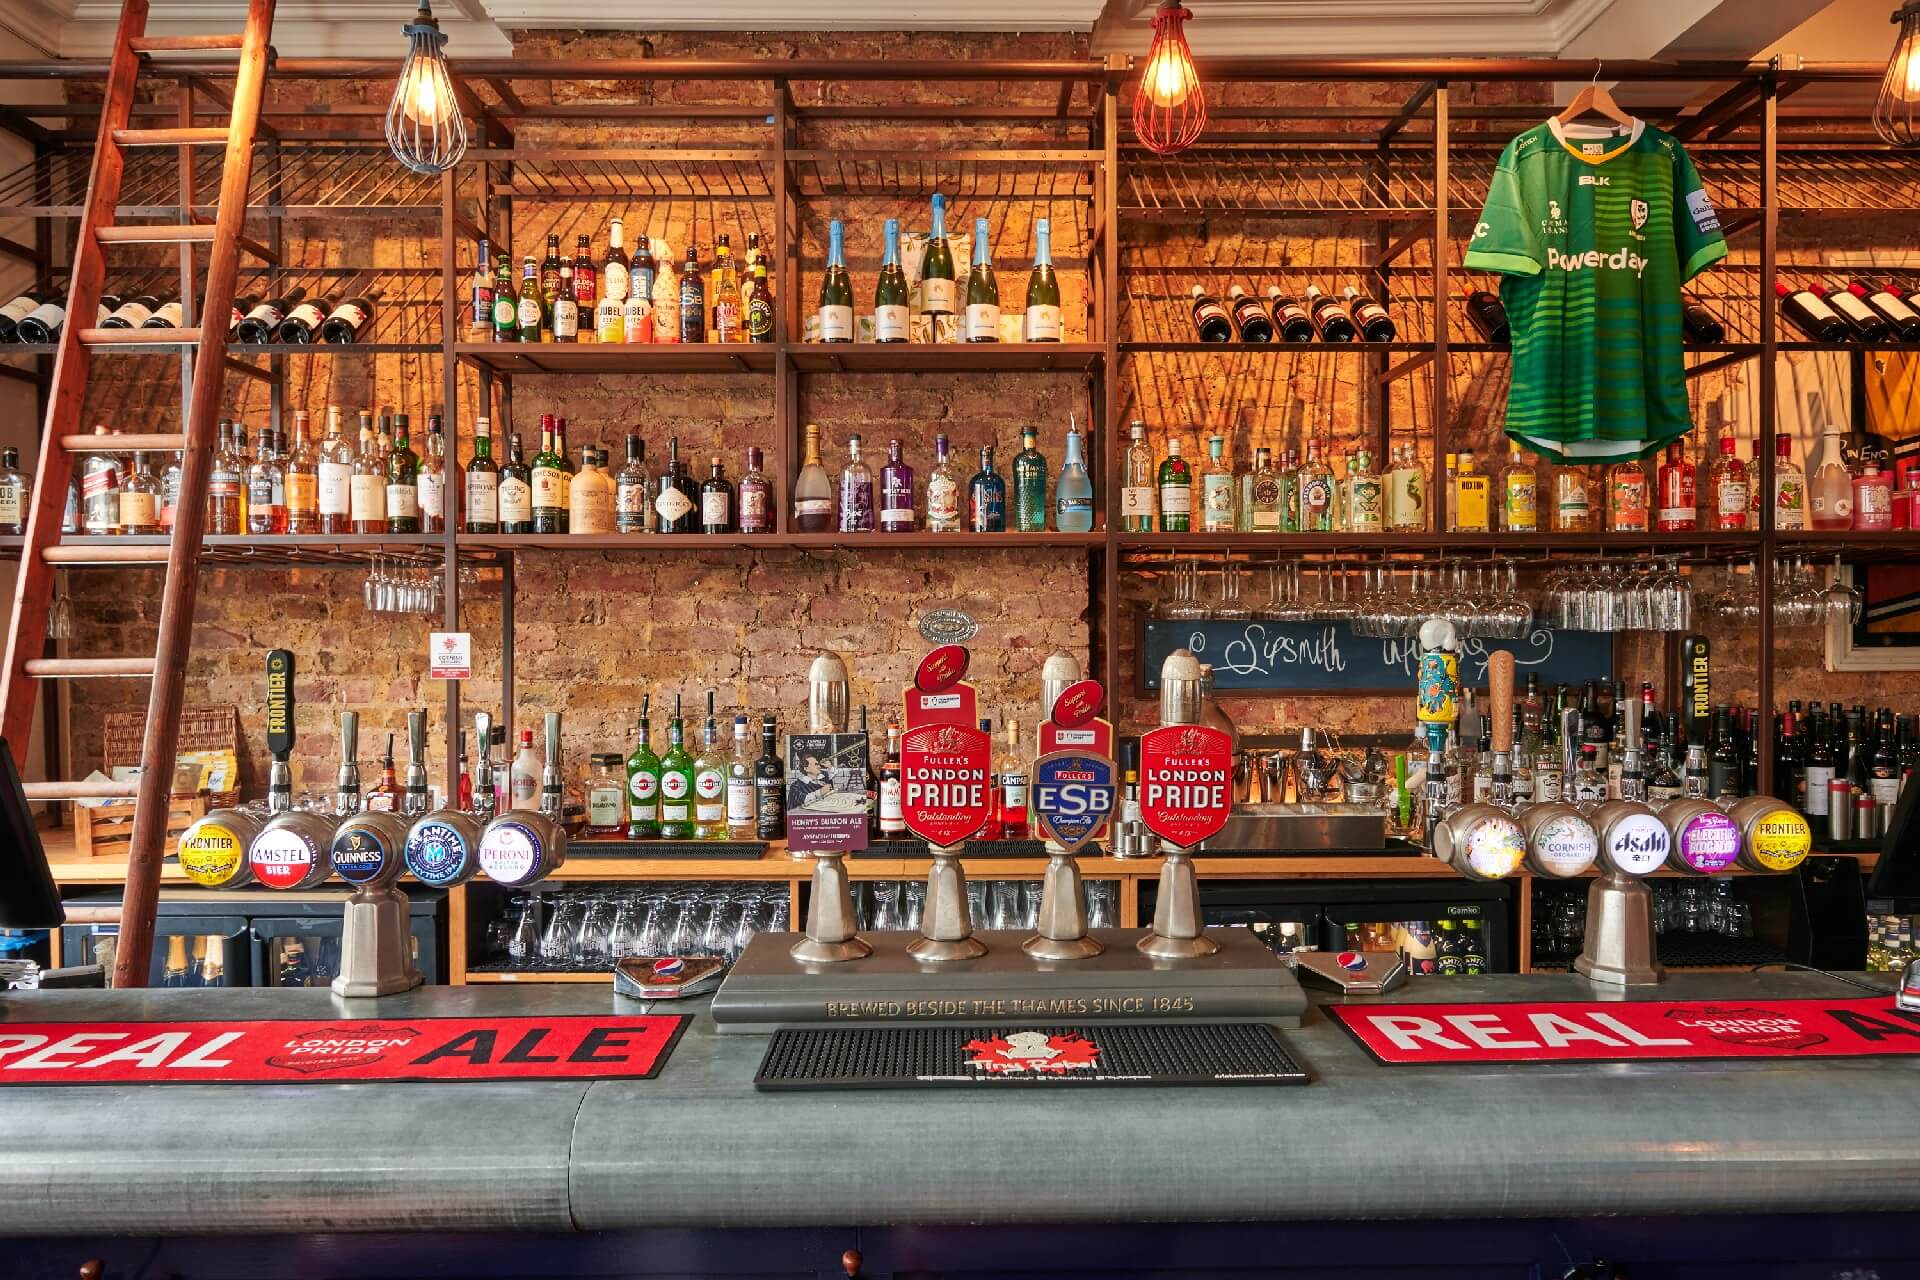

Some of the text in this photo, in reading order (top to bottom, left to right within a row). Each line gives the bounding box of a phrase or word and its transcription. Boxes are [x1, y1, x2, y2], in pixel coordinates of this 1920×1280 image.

[1578, 175, 1611, 186] BLK
[1547, 247, 1649, 279] Powerday
[600, 306, 622, 317] JUBEL
[625, 306, 645, 317] JUBEL
[1461, 480, 1484, 490] HOXTON
[1128, 494, 1138, 507] 3
[1225, 624, 1346, 675] Sipsmith
[1693, 656, 1709, 718] FRONTIER
[268, 672, 286, 734] FRONTIER
[1064, 689, 1087, 707] Support
[923, 755, 969, 765] FULLER'S
[1164, 757, 1210, 767] FULLER'S
[906, 767, 984, 780] LONDON
[1002, 775, 1026, 785] CAMPA
[1147, 769, 1225, 782] LONDON
[881, 788, 900, 796] PIMM
[906, 782, 983, 807] PRIDE
[1147, 784, 1225, 808] PRIDE
[1038, 783, 1110, 816] ESB
[791, 818, 819, 826] HENRY'S
[849, 817, 862, 825] ALE
[917, 810, 972, 824] Outstanding
[1157, 811, 1213, 825] Outstanding
[1760, 823, 1806, 835] FRONTIER
[185, 837, 233, 849] FRONTIER
[408, 826, 463, 853] MEANTIME
[1615, 831, 1666, 853] Asahi
[484, 848, 529, 860] PERONI
[1548, 843, 1591, 853] CORNISH
[254, 849, 305, 861] AMSTEL
[333, 851, 382, 864] GUINNESS
[266, 865, 291, 876] BIER
[825, 995, 1195, 1017] BREWED BESIDE THE THAMES SINCE 1845
[1677, 1018, 1802, 1028] LONDON
[1707, 1025, 1801, 1034] PRIDE
[1368, 1011, 1694, 1050] REAL
[284, 1038, 412, 1048] LONDON
[408, 1027, 646, 1065] ALE
[290, 1047, 385, 1055] PRIDE
[964, 1058, 1098, 1075] Tiny Rebel
